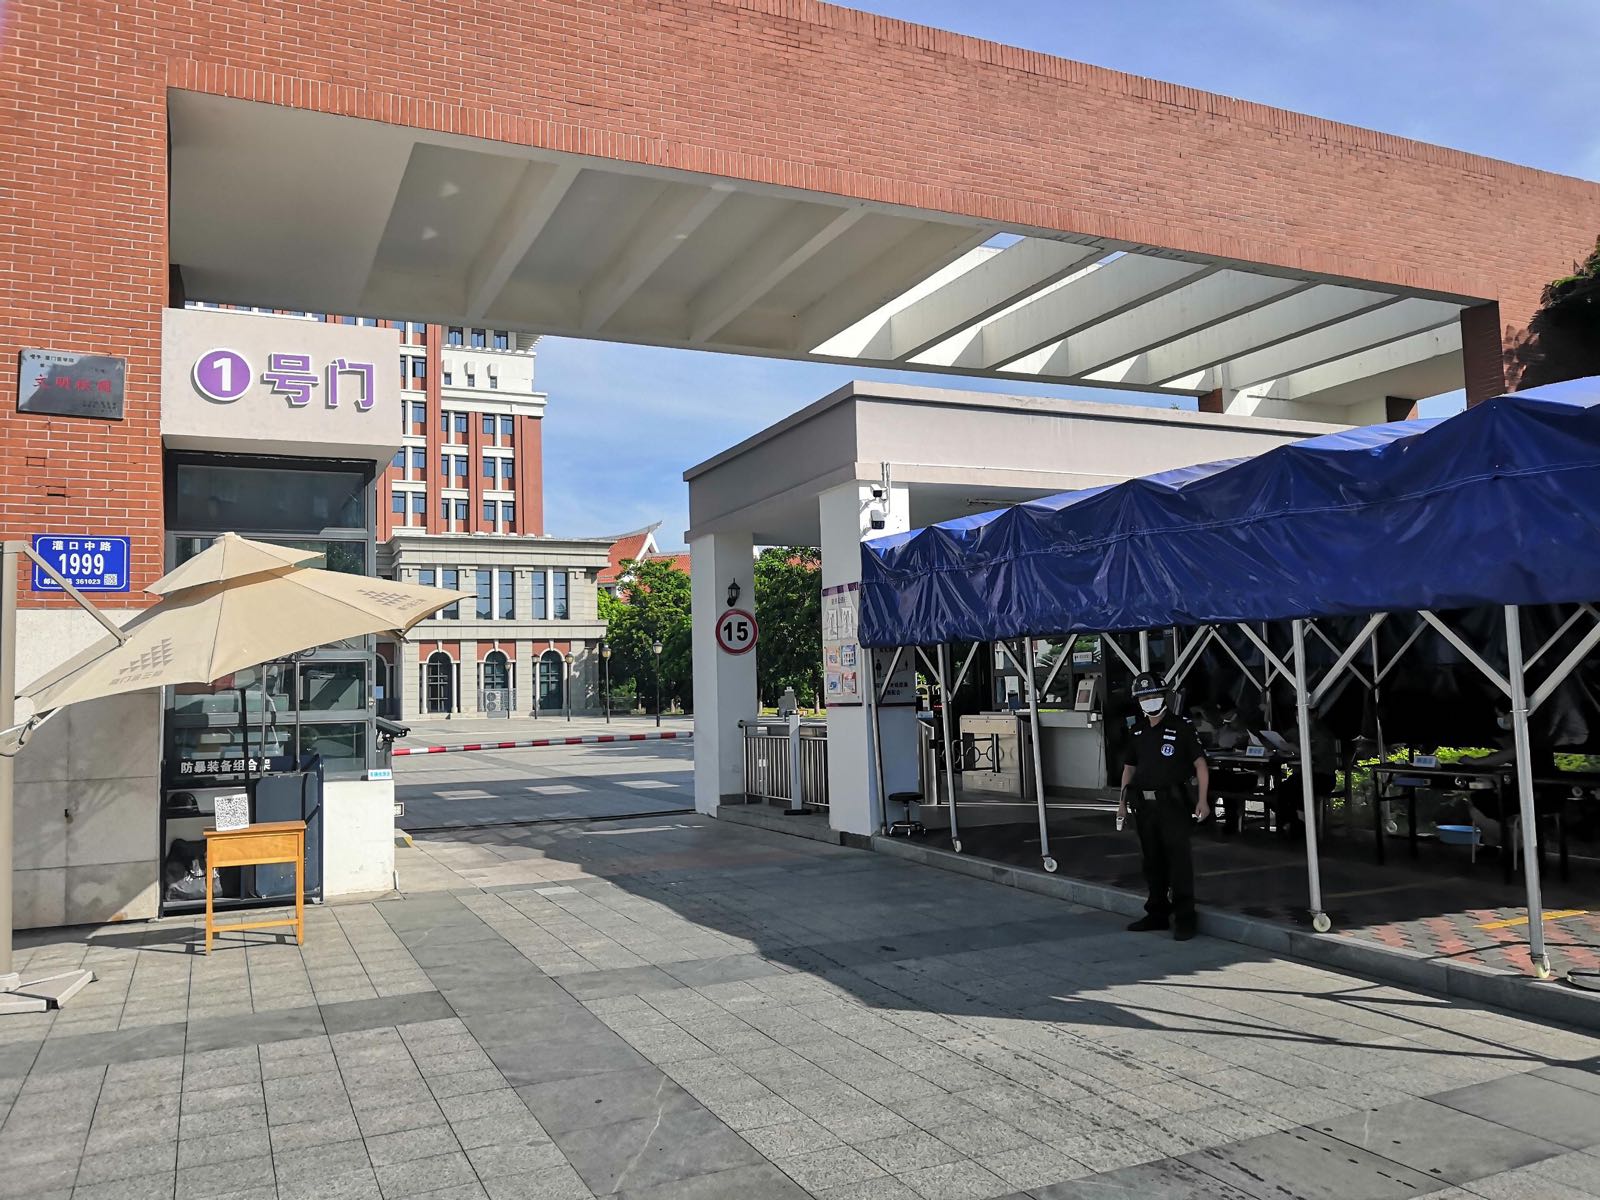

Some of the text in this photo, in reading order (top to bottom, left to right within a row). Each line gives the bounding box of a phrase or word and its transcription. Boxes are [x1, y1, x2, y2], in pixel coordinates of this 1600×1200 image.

[52, 540, 112, 552] 灌口中路
[59, 553, 104, 575] 1999
[723, 621, 748, 642] 15
